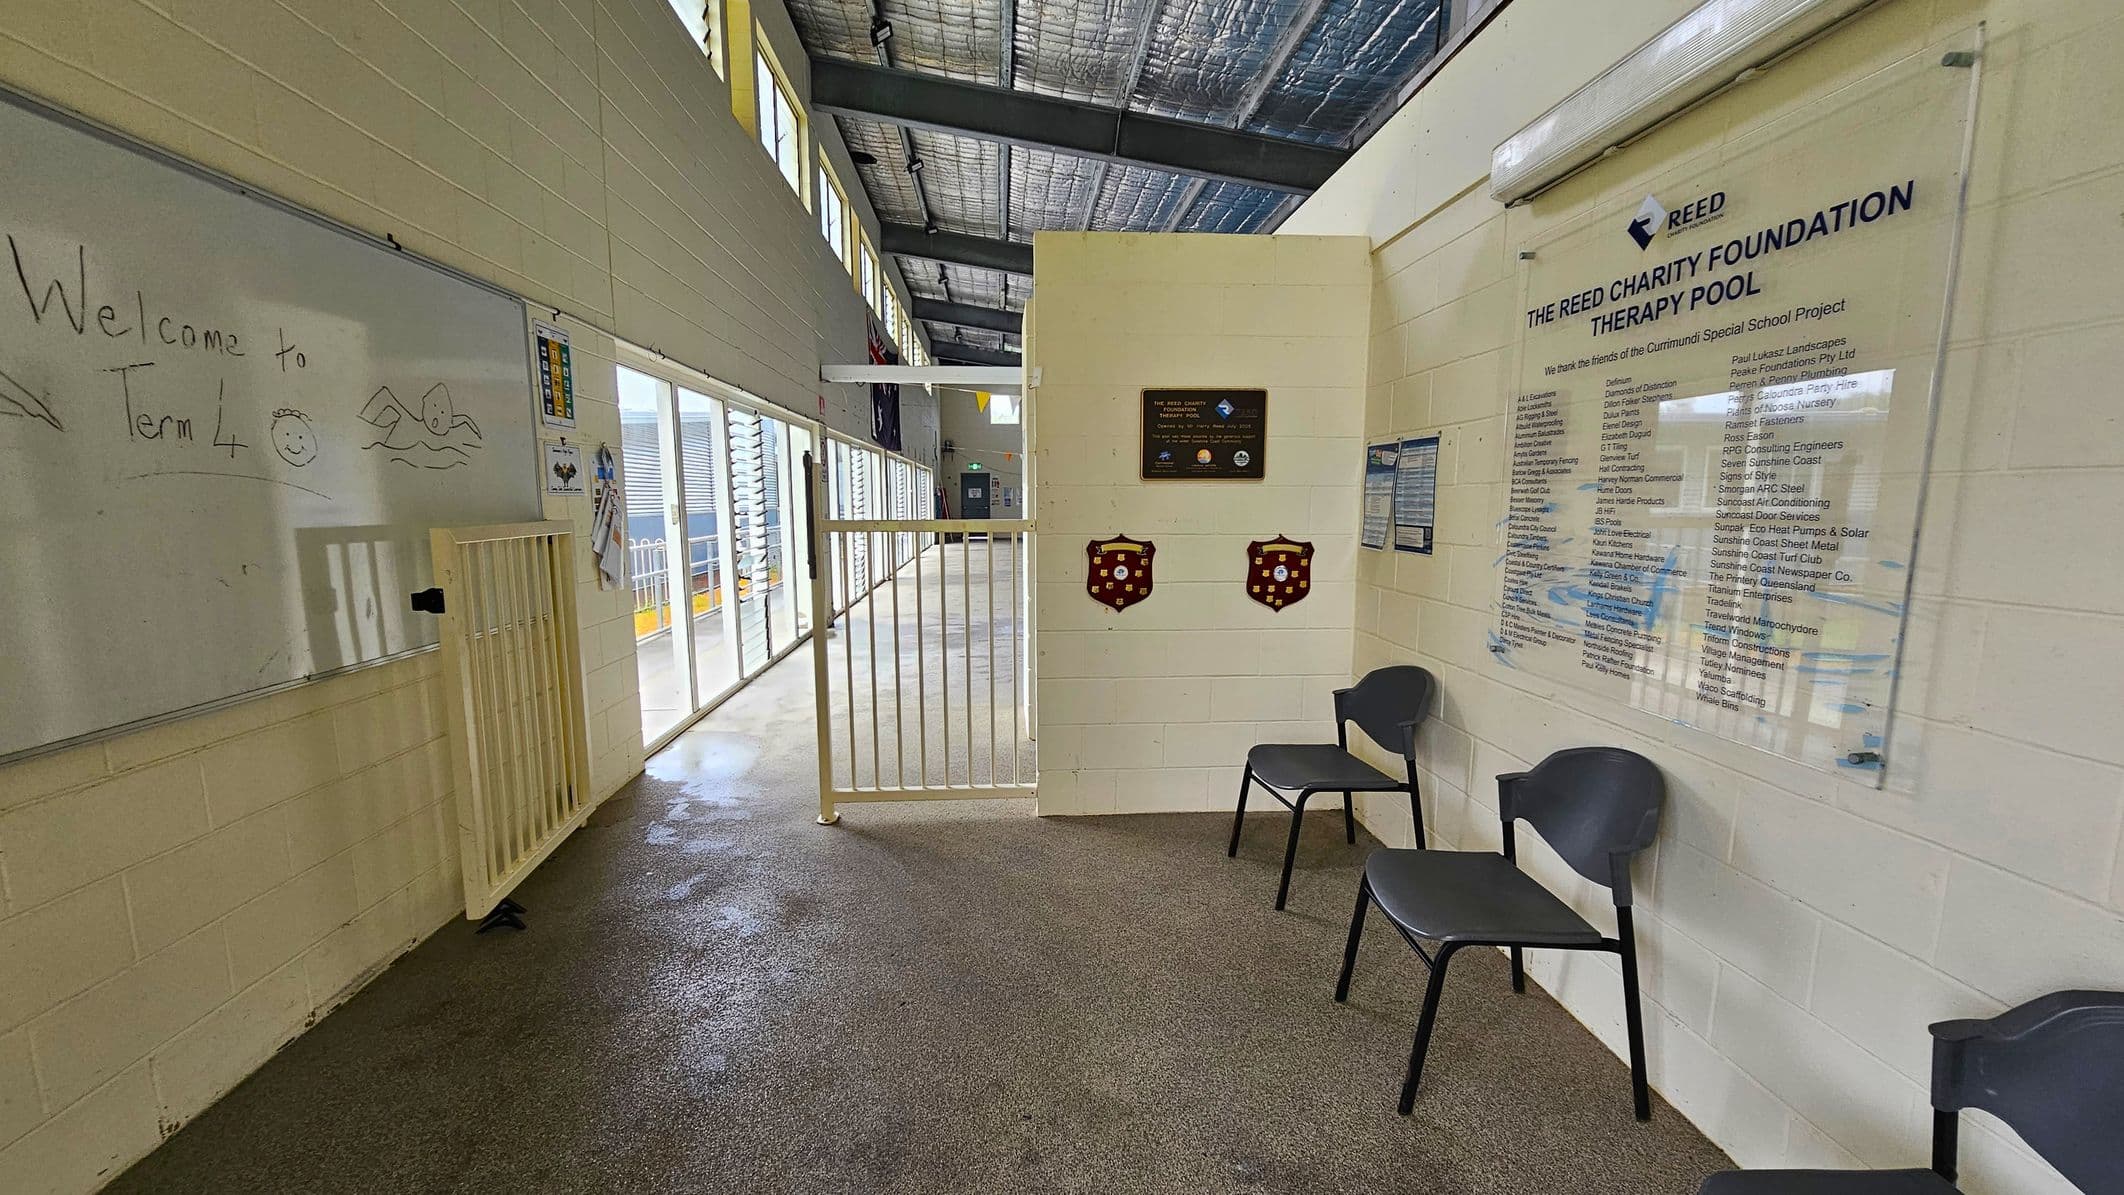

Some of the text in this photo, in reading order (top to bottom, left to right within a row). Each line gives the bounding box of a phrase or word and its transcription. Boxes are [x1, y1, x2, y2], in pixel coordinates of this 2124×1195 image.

[1668, 192, 1725, 230] REED
[1667, 214, 1724, 239] CHARITY FOUNDATION
[1526, 179, 1914, 328] THE REED CHARITY FOUNDATION
[8, 234, 306, 372] Welcome to
[1590, 268, 1762, 337] THERAPY POOL
[1544, 297, 1846, 376] We thank the friends of the Currimundi Special School Project
[1732, 338, 1846, 364] Paul Lukasz Landscapes
[1730, 349, 1855, 377] Peake Foundations Pty Ltd
[1759, 376, 1766, 386] &
[1768, 374, 1797, 385] Penny
[1800, 367, 1847, 381] Plumbing
[1604, 380, 1676, 398] Diamonds of Distinction
[1756, 386, 1803, 400] Caloundra
[1806, 382, 1832, 395] Party
[1835, 380, 1857, 391] Hire
[102, 362, 249, 458] Term 4
[1620, 408, 1639, 417] Paints
[1726, 398, 1836, 416] Plants of Noosa Nursery
[1725, 415, 1804, 429] Ramset Fasteners
[1601, 429, 1651, 440] Elizabeth Duguid
[1724, 431, 1774, 442] Ross Eason
[1627, 452, 1639, 460] Turf
[1722, 441, 1843, 454] RPG Consulting Engineers
[1720, 455, 1821, 467] Seven Sunshine Coast
[1598, 475, 1618, 484] Harvey
[1644, 473, 1684, 482] Commercial
[1719, 470, 1776, 482] Signs of Style
[1718, 483, 1805, 495] Smorgan ARC Steel
[1596, 496, 1614, 504] James
[1636, 497, 1664, 505] Products
[1716, 497, 1830, 510] Suncoast Air Conditioning
[1715, 509, 1820, 521] Suncoast Door Services
[1608, 528, 1622, 536] Love
[1623, 529, 1651, 538] Electrical
[1749, 523, 1766, 533] Eco
[1768, 524, 1790, 534] Heat
[1792, 525, 1826, 538] Pumps
[1829, 526, 1837, 536] &
[1840, 527, 1869, 538] Solar
[1712, 534, 1839, 551] Sunshine Coast Sheet Metal
[1614, 550, 1632, 559] Home
[1634, 552, 1664, 562] Hardware
[1711, 546, 1822, 564] Sunshine Coast Turf Club
[1710, 559, 1852, 582] Sunshine Coast Newspaper Co.
[1708, 571, 1815, 592] The Printery Queensland
[1604, 591, 1653, 607] Christian Church
[1706, 595, 1742, 609] Tradelink
[1707, 583, 1793, 603] Titanium Enterprises
[1703, 620, 1766, 639] Trend Windows
[1705, 608, 1818, 635] Travelworld Maroochydore
[1606, 623, 1661, 644] Concrete Pumping
[1731, 637, 1790, 658] Constructions
[1701, 644, 1785, 670] Village Management
[1620, 659, 1654, 675] Foundation
[1698, 667, 1731, 684] Yalumba
[1724, 661, 1766, 679] Nominees
[1696, 691, 1739, 711] Whale Bins
[1697, 679, 1765, 708] Waco Scaffolding
